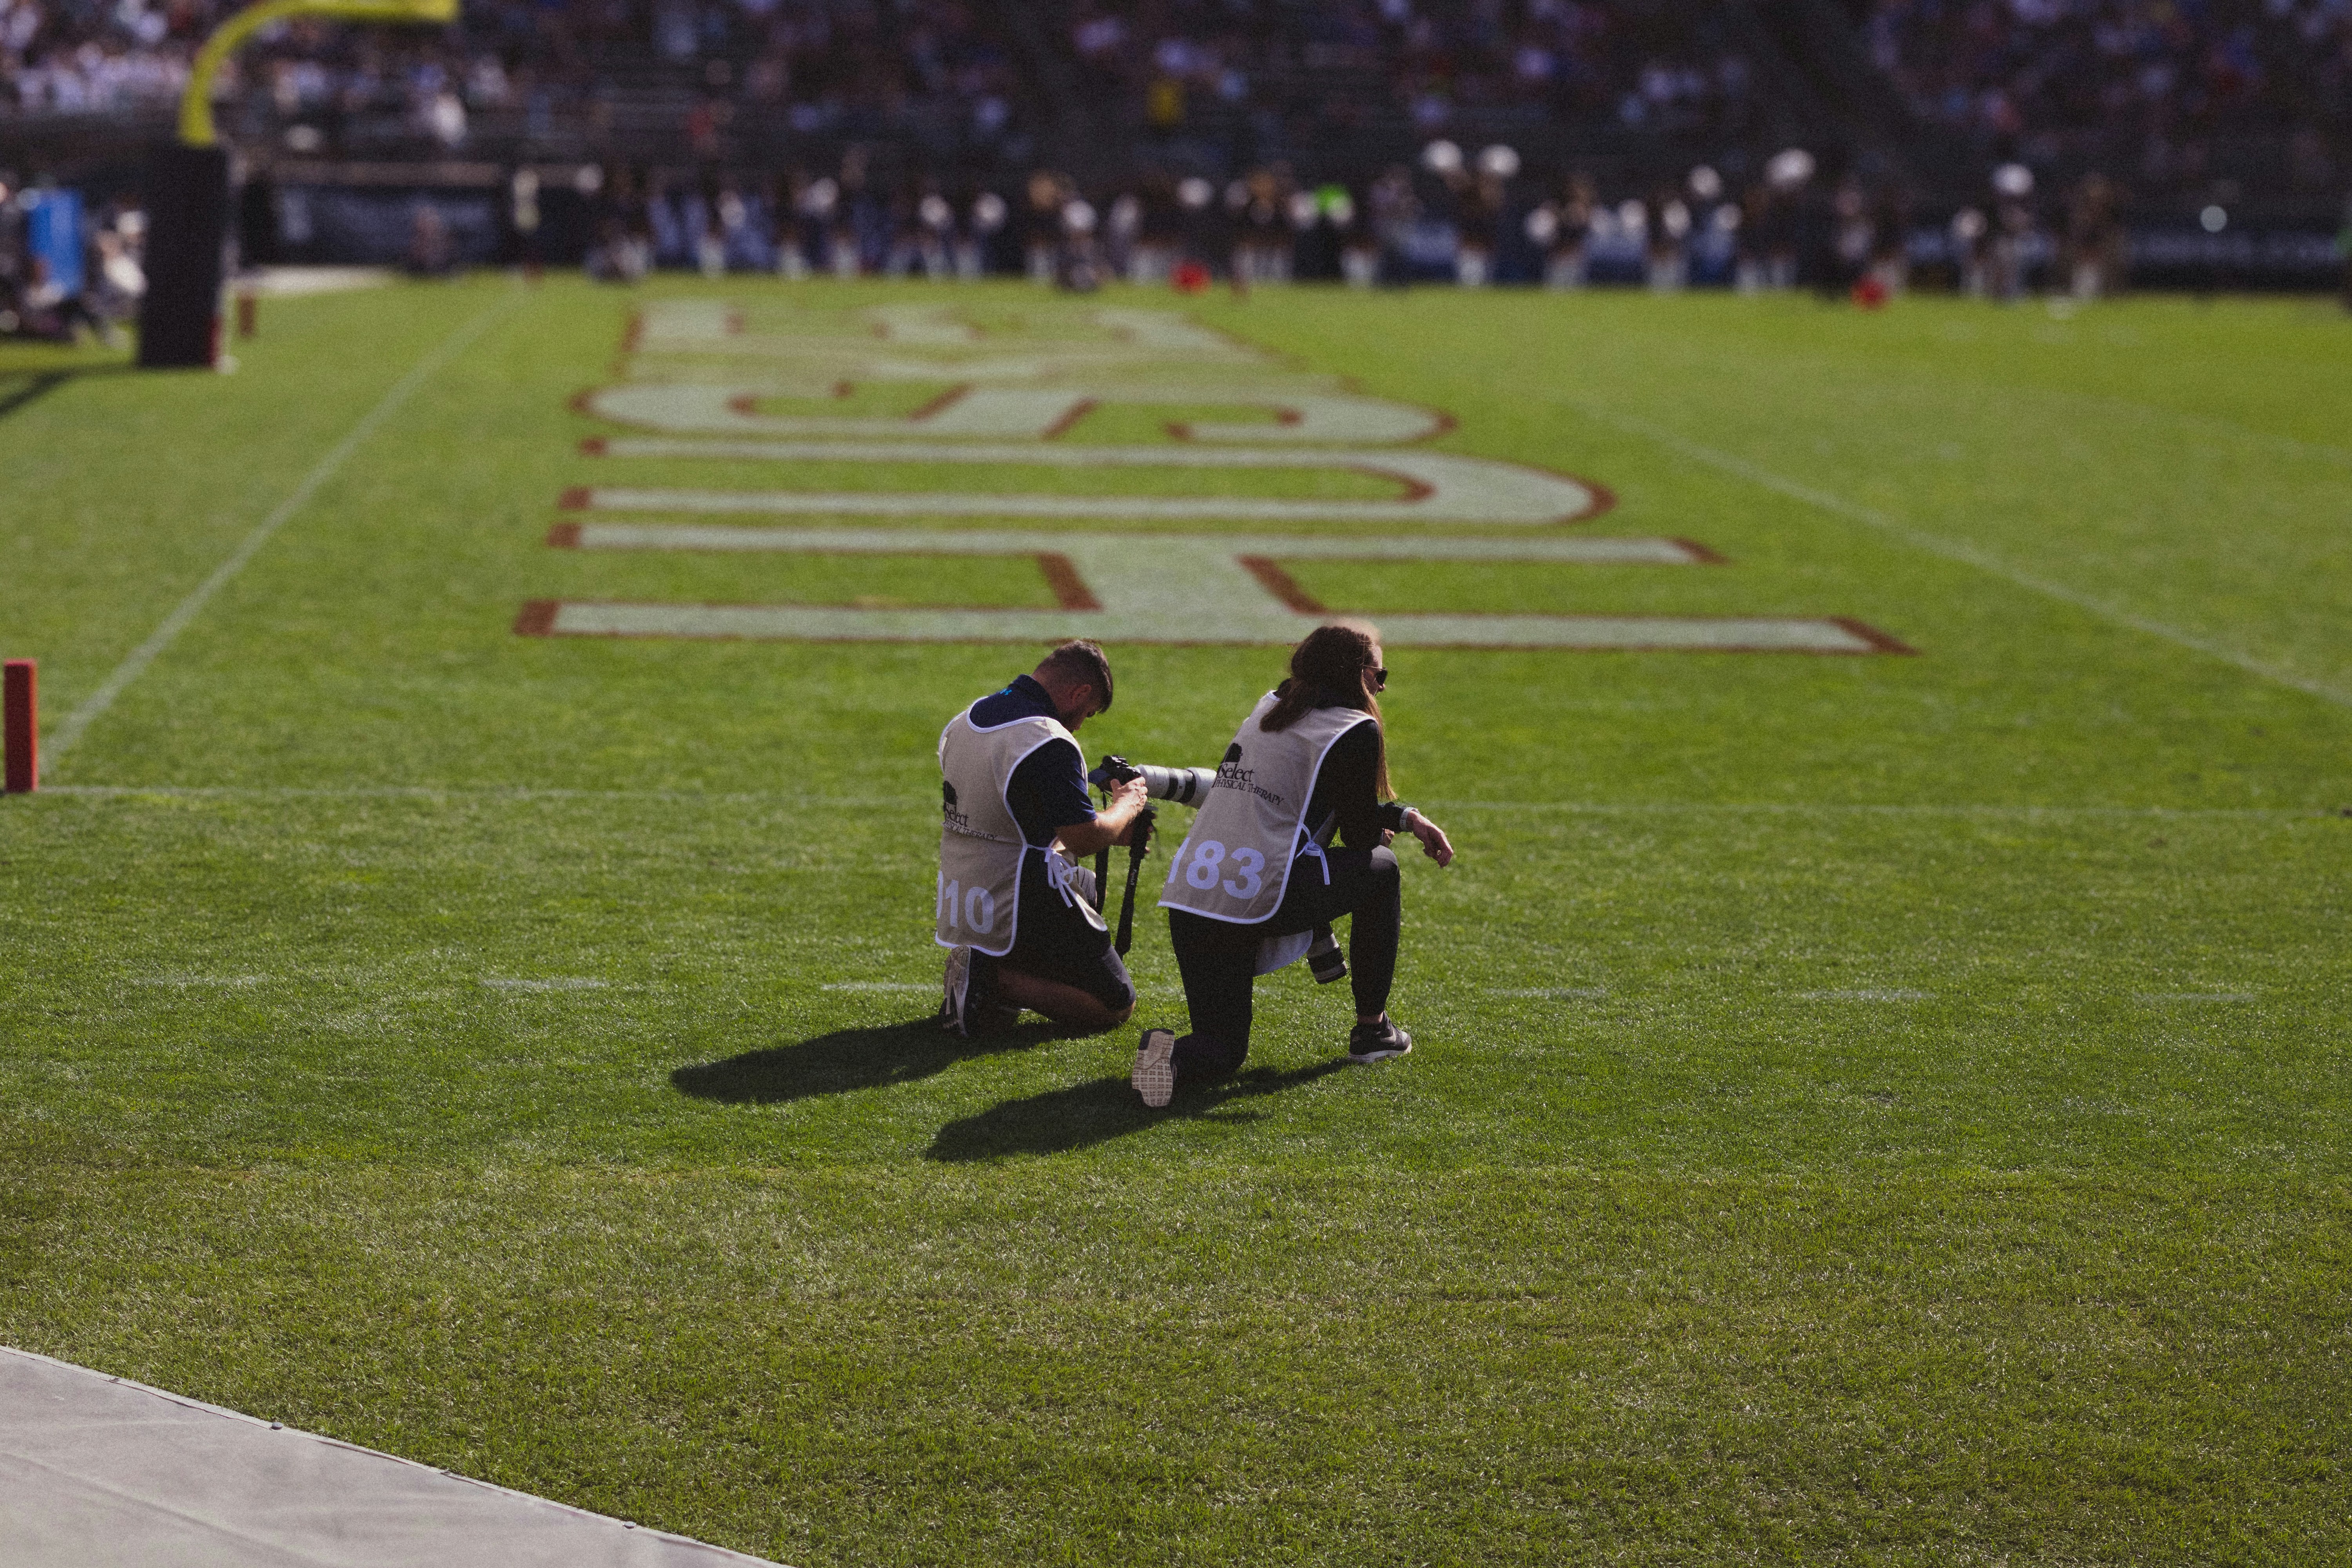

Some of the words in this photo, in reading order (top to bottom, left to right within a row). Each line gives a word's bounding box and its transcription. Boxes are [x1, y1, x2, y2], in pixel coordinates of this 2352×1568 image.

[1218, 763, 1255, 783] Select
[1215, 779, 1246, 791] PHYSICAL
[1247, 783, 1285, 806] THERAPY
[945, 803, 969, 827] Select
[963, 828, 998, 841] THERAPY
